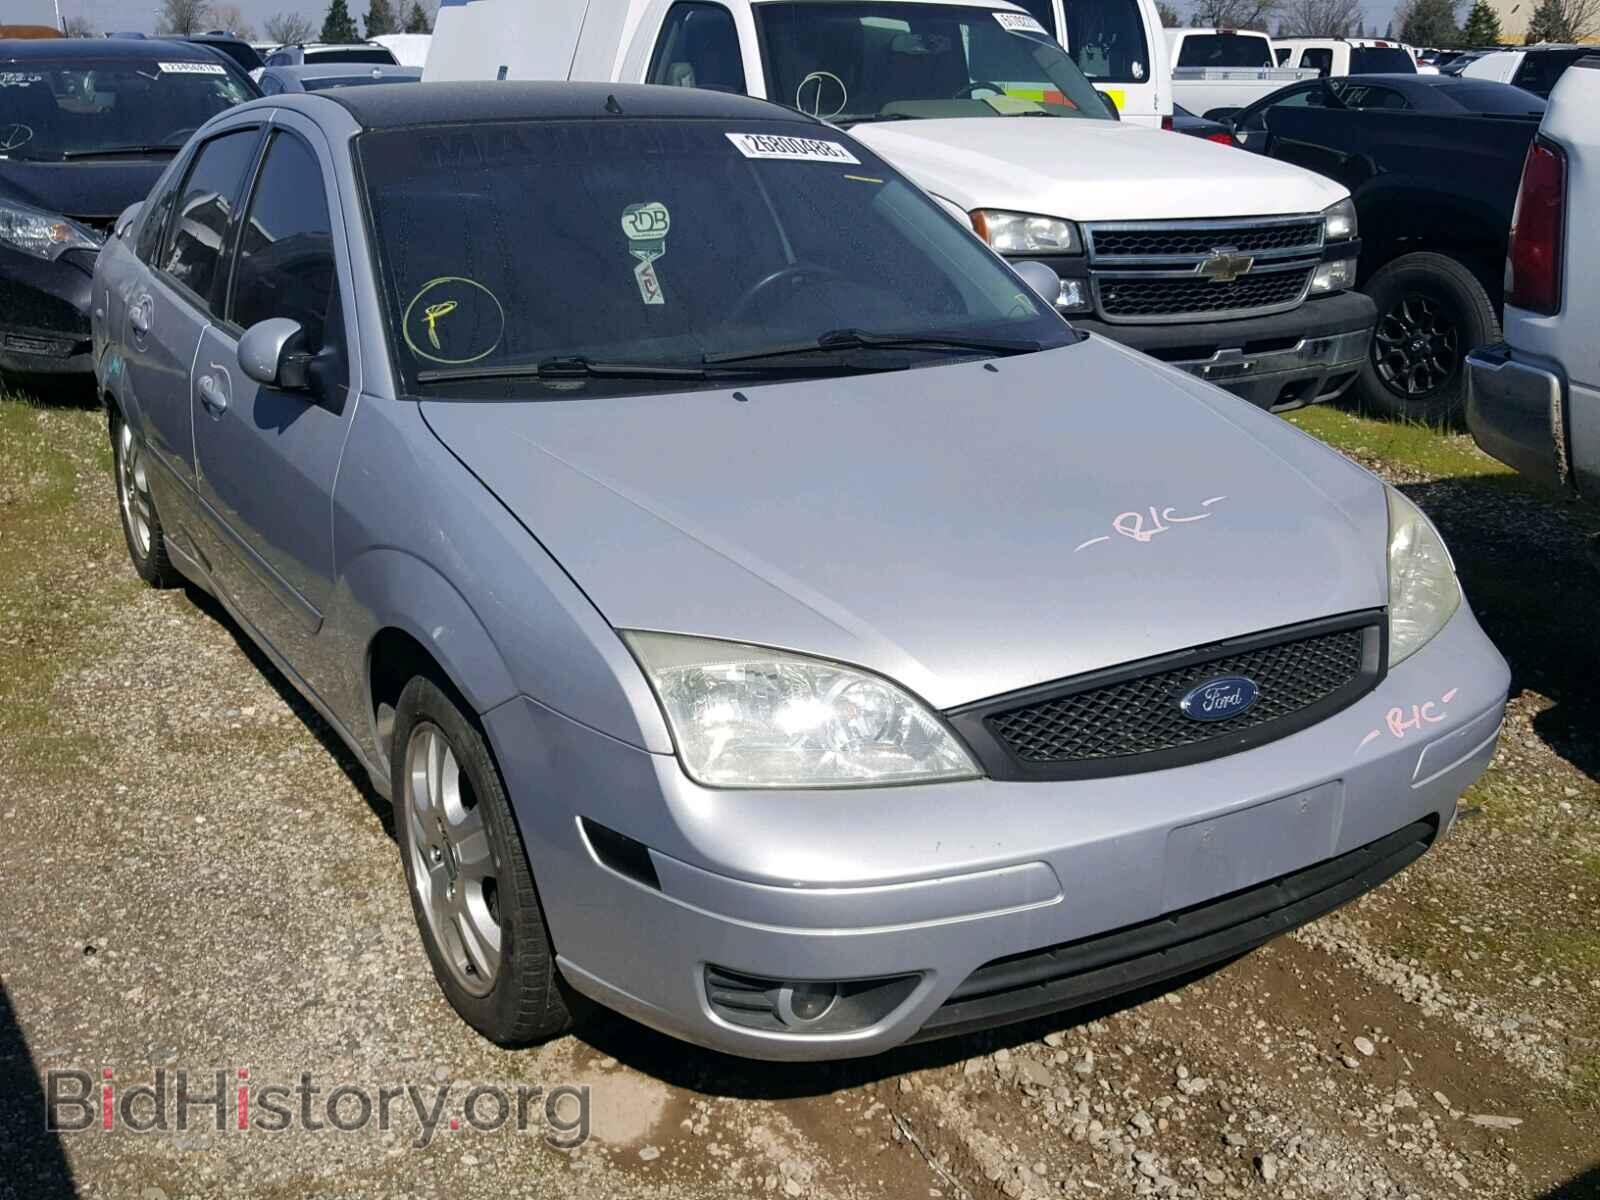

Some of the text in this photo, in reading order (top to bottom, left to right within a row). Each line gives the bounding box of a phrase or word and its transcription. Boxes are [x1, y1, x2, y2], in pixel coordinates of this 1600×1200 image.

[744, 134, 840, 157] 26800488
[622, 209, 668, 232] RDB
[1202, 685, 1243, 712] Ford
